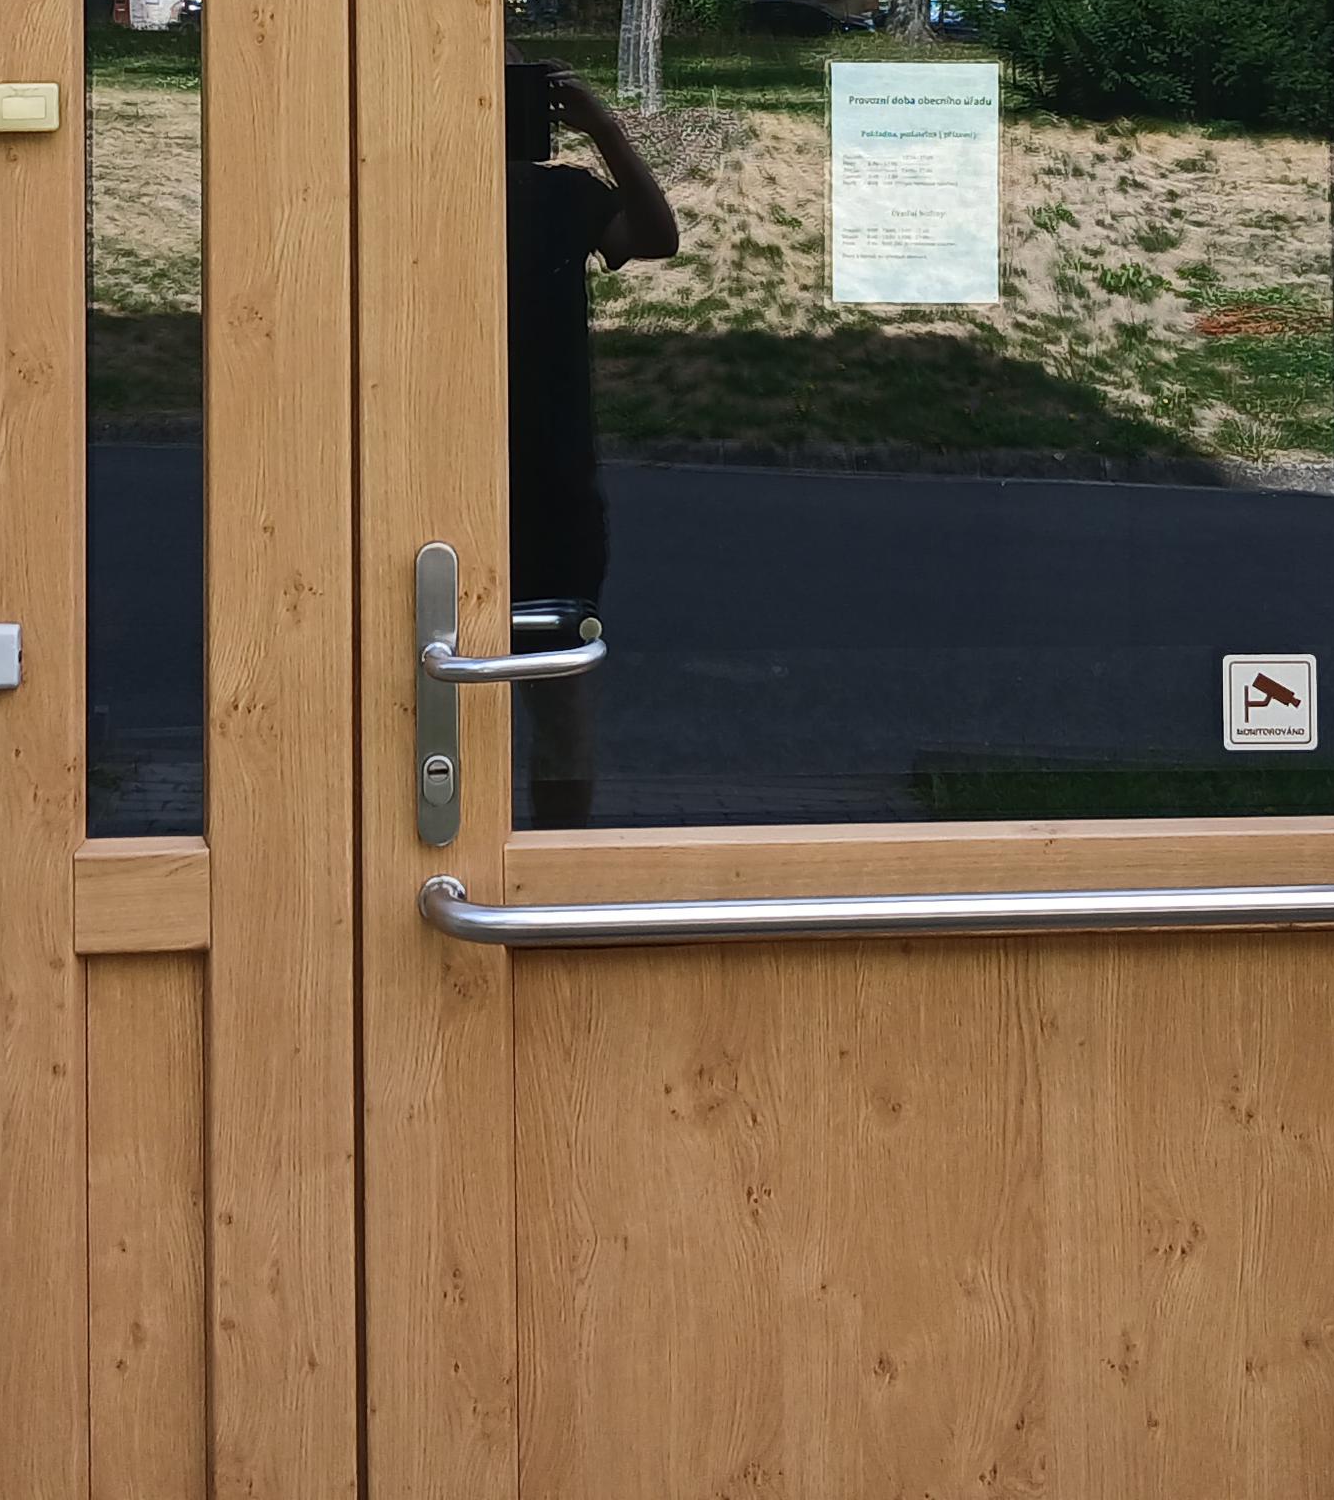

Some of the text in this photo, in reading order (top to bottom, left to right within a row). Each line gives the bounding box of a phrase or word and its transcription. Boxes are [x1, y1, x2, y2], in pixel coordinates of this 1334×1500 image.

[849, 95, 992, 106] Provozní doba obecního úřadu
[1236, 726, 1305, 736] MONITOROVÁNO
